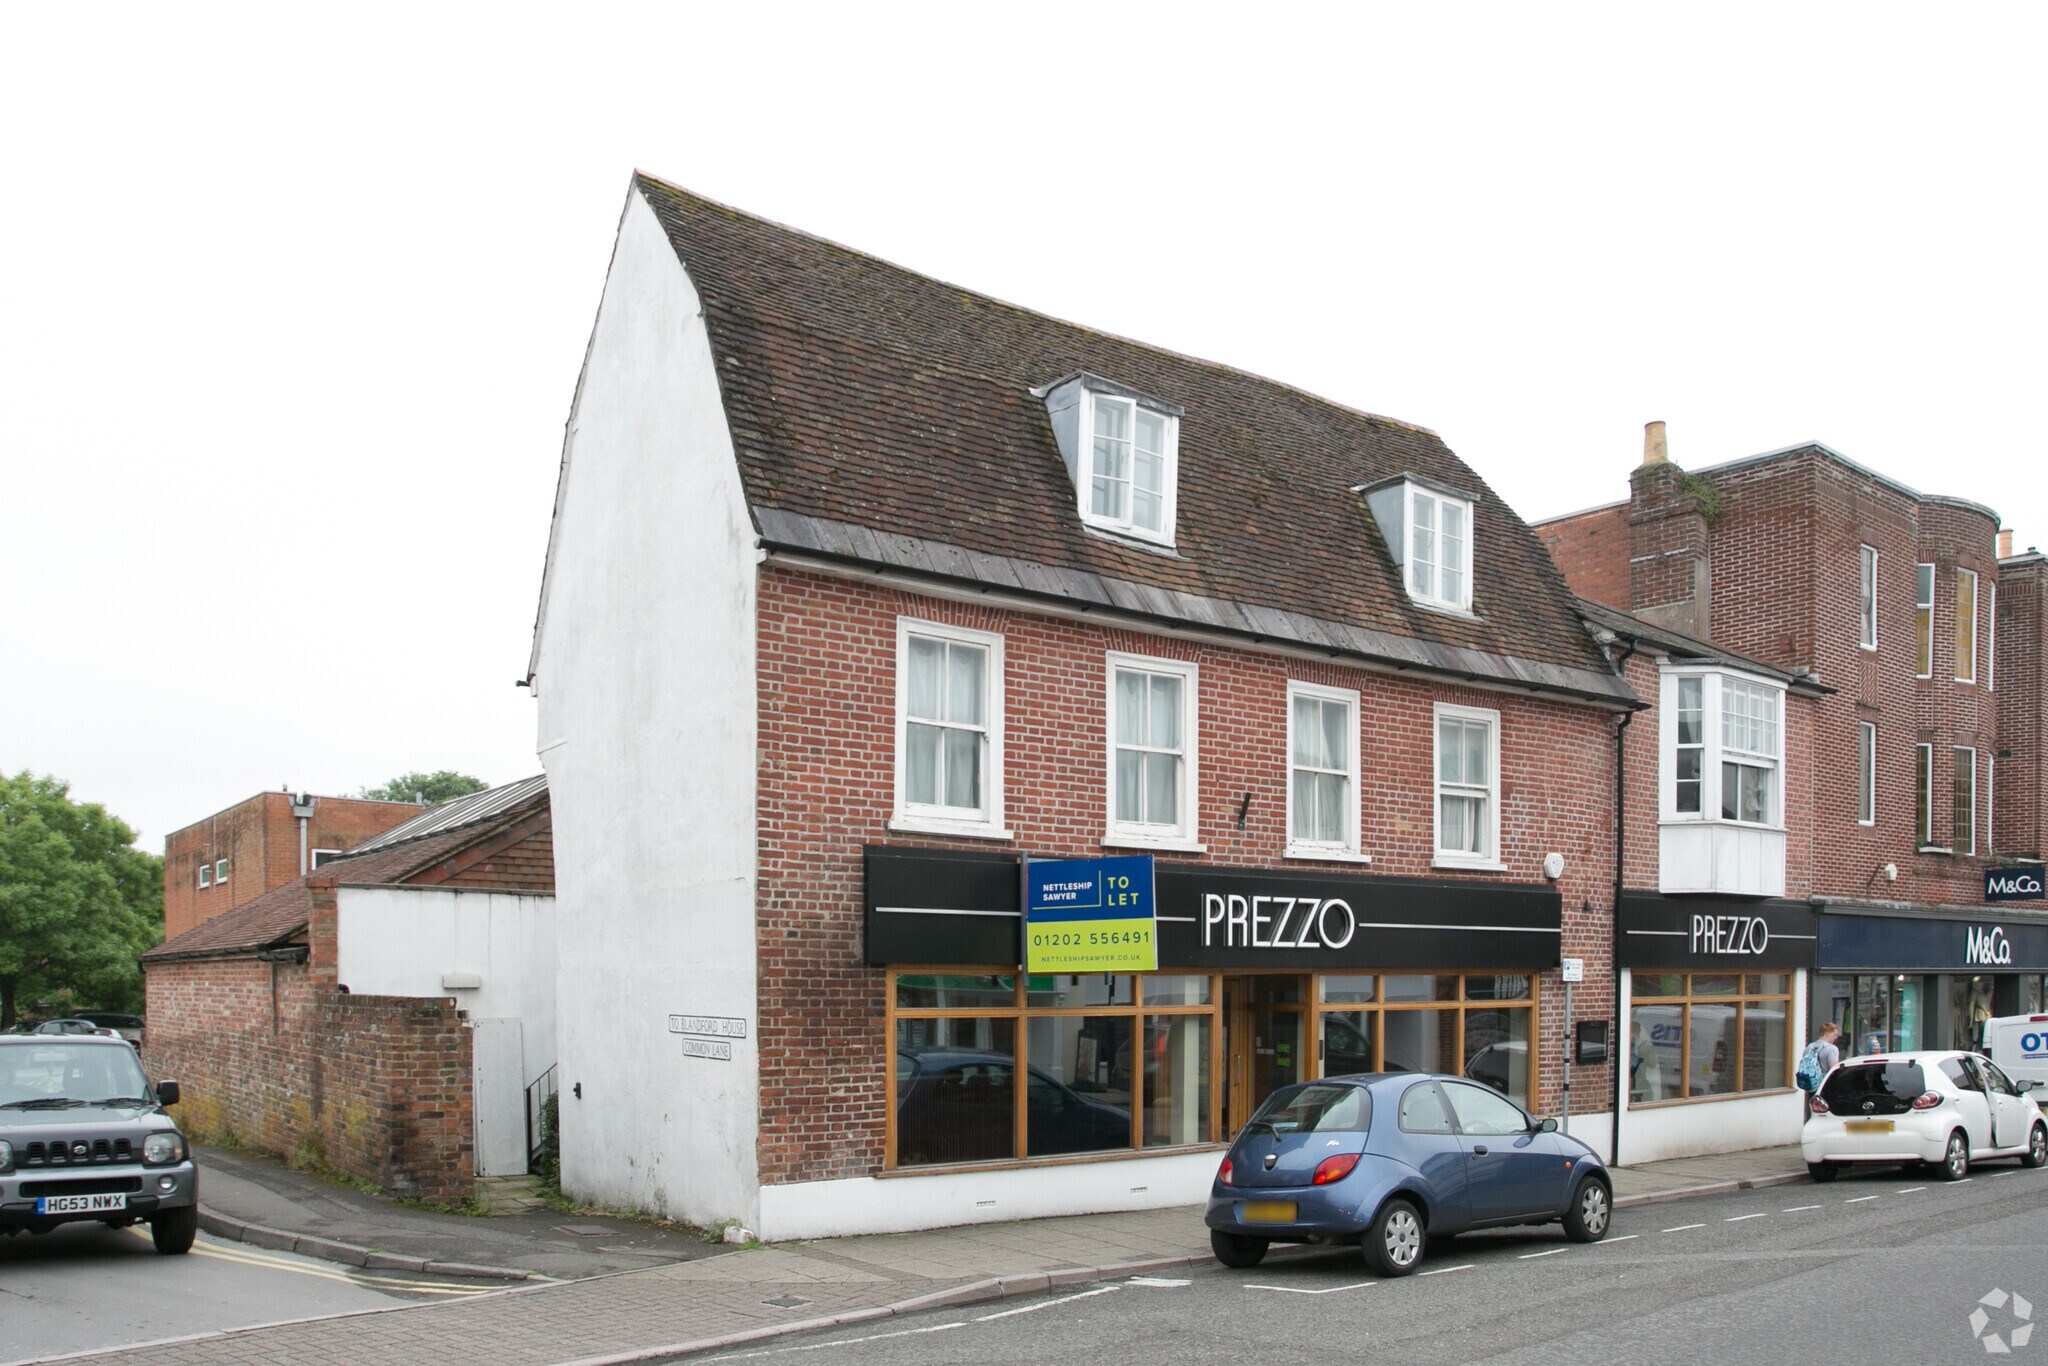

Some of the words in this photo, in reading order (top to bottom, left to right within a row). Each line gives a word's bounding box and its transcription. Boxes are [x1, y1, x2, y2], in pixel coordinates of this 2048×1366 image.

[1043, 881, 1093, 892] NETTLESHIP
[1107, 876, 1129, 889] TO
[1988, 875, 2042, 893] M&Co.
[1043, 892, 1077, 901] SAWYER
[1108, 893, 1139, 906] LET
[1204, 893, 1355, 949] PREZZO
[1034, 933, 1081, 947] 01202
[1090, 931, 1149, 945] 556491
[1690, 914, 1768, 954] PREZZO
[1965, 926, 2011, 964] M&Co.
[1041, 954, 1141, 963] NETTLESHIPSAWYER.CO.UK
[681, 1017, 718, 1033] BLANDFORD
[722, 1020, 744, 1035] HOUSE
[685, 1041, 710, 1055] COMMON
[712, 1044, 728, 1057] LANE
[48, 1197, 88, 1211] HG53
[93, 1195, 122, 1208] NWX
